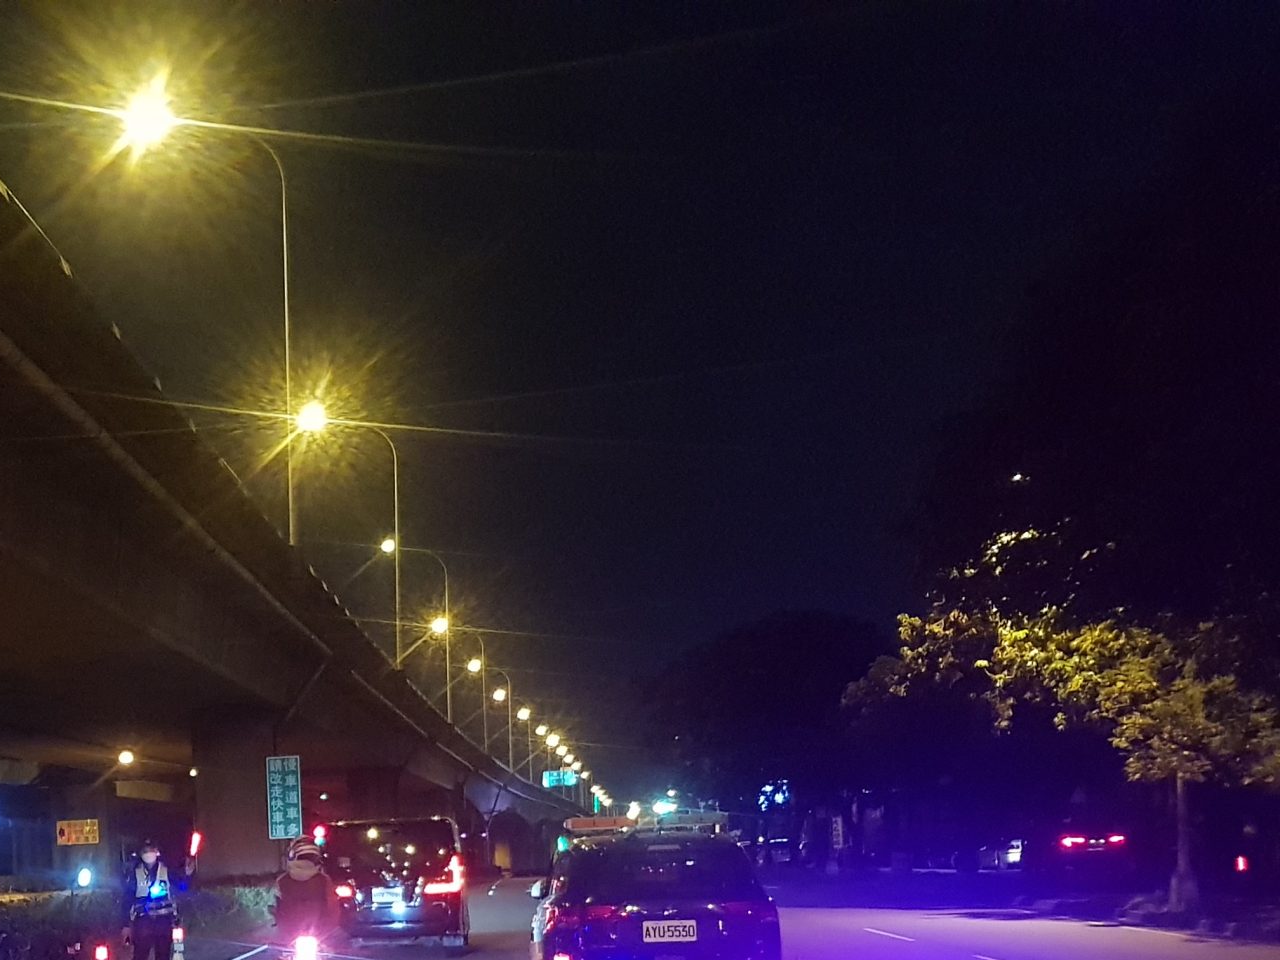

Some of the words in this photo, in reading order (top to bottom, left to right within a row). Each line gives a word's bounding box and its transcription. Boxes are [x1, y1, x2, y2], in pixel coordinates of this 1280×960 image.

[269, 760, 285, 837] 請改走快車道
[283, 758, 299, 836] 慢車道車多
